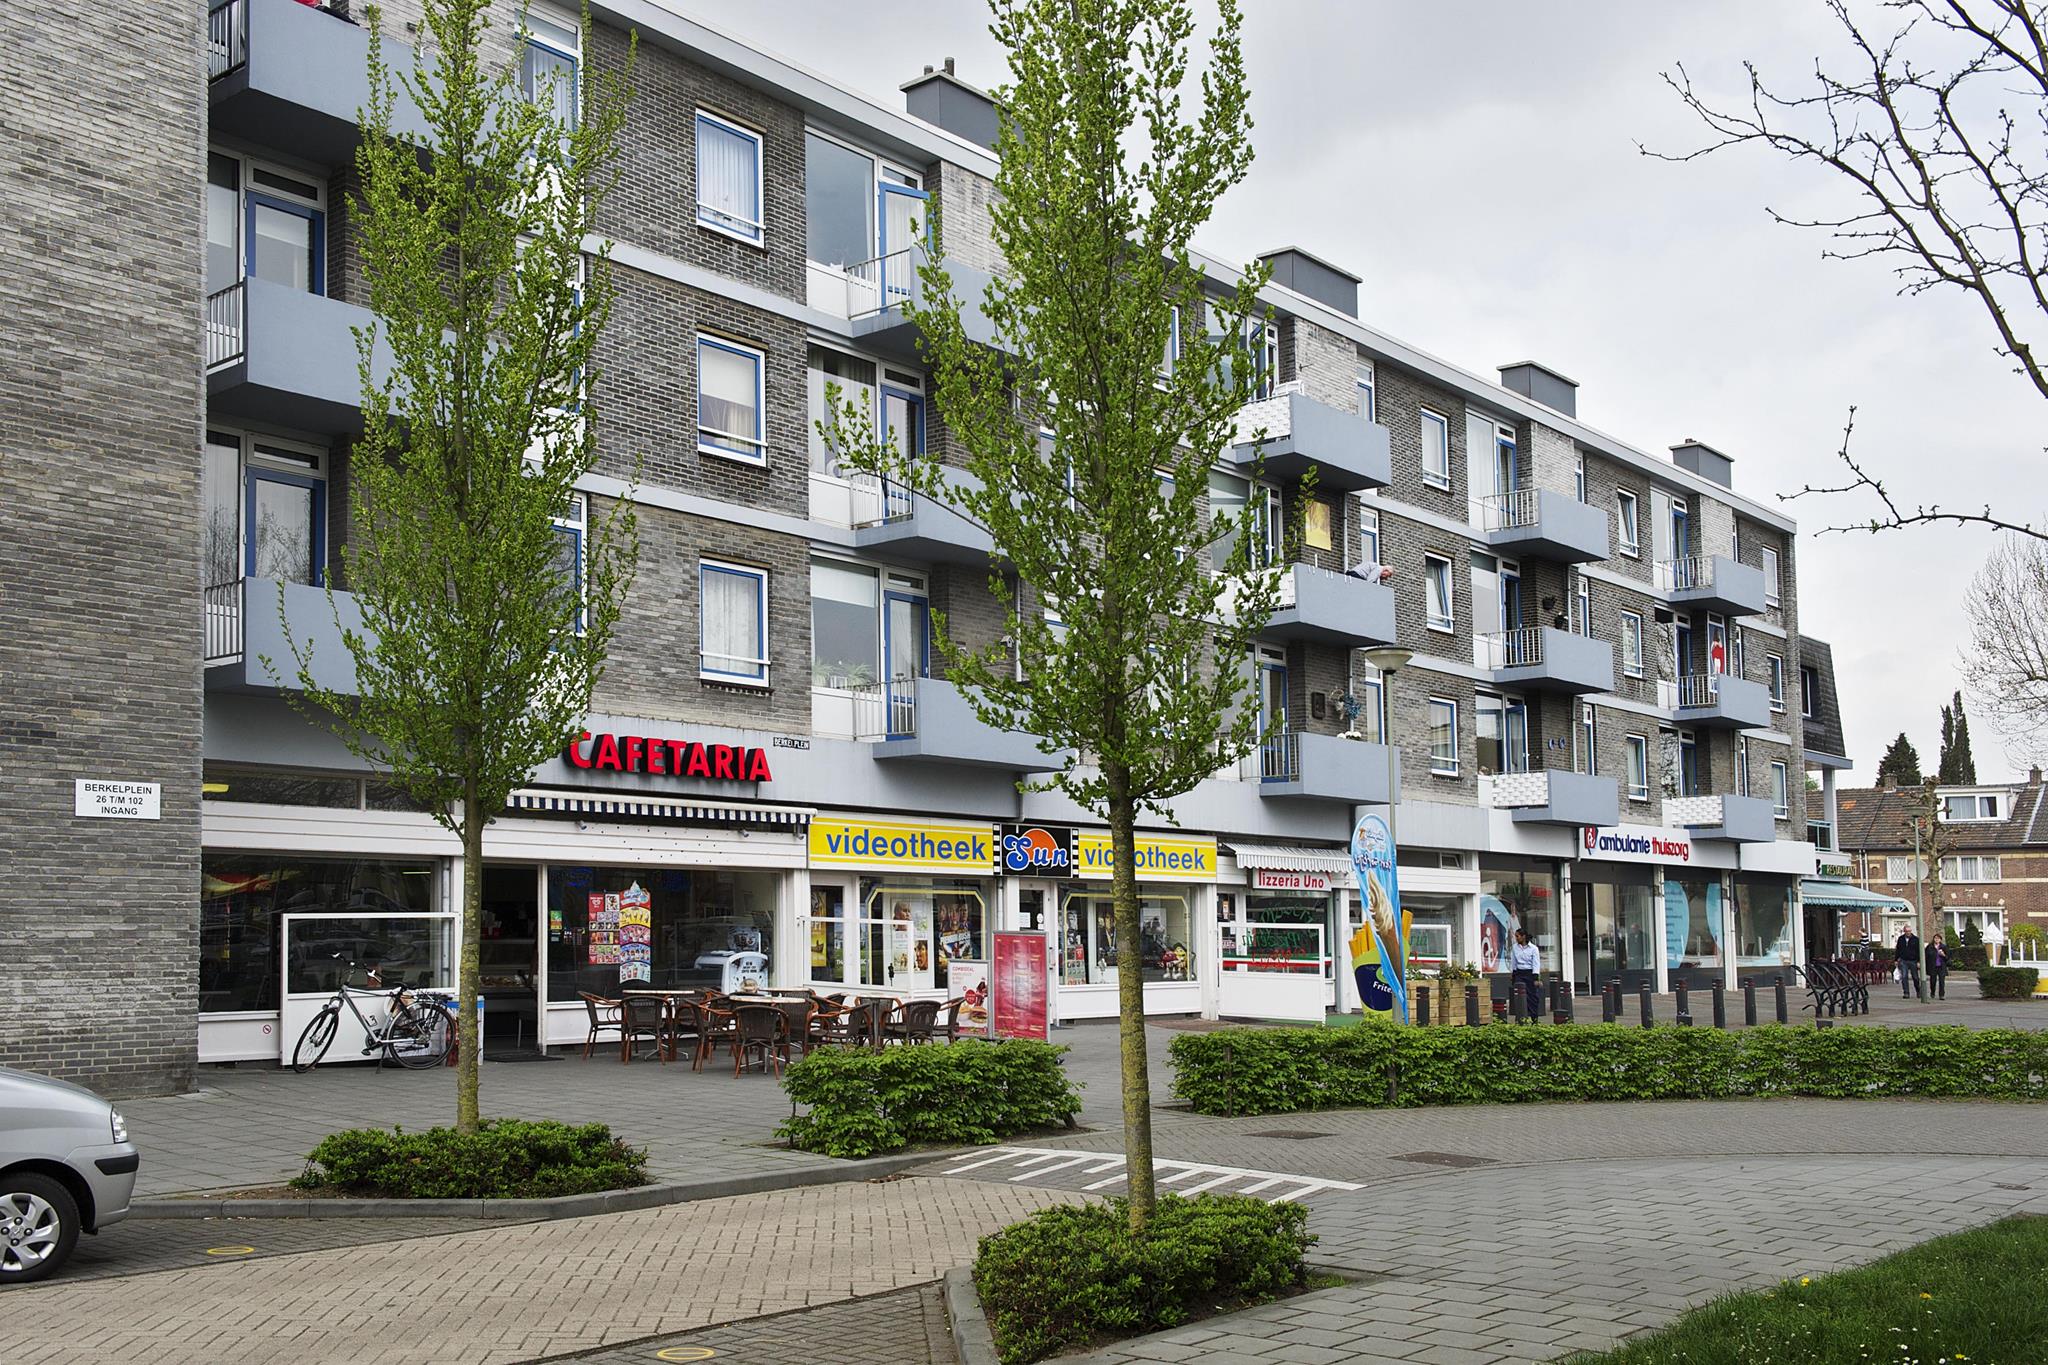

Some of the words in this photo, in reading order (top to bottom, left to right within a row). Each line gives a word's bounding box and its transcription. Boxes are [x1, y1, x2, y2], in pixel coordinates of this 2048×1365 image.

[568, 731, 772, 782] CAFETARIA
[84, 783, 152, 795] BERKELPLEIN
[96, 795, 107, 804] 26
[109, 796, 126, 804] T/M
[128, 797, 143, 805] 102
[101, 806, 138, 815] INGANG
[826, 828, 987, 861] videotheek
[1003, 834, 1069, 871] Sun
[1599, 833, 1651, 854] ambulante
[1651, 836, 1689, 862] thuiszorg
[1085, 843, 1205, 870] vidotheek
[1303, 874, 1324, 888] Uno
[1372, 981, 1393, 994] Frite
